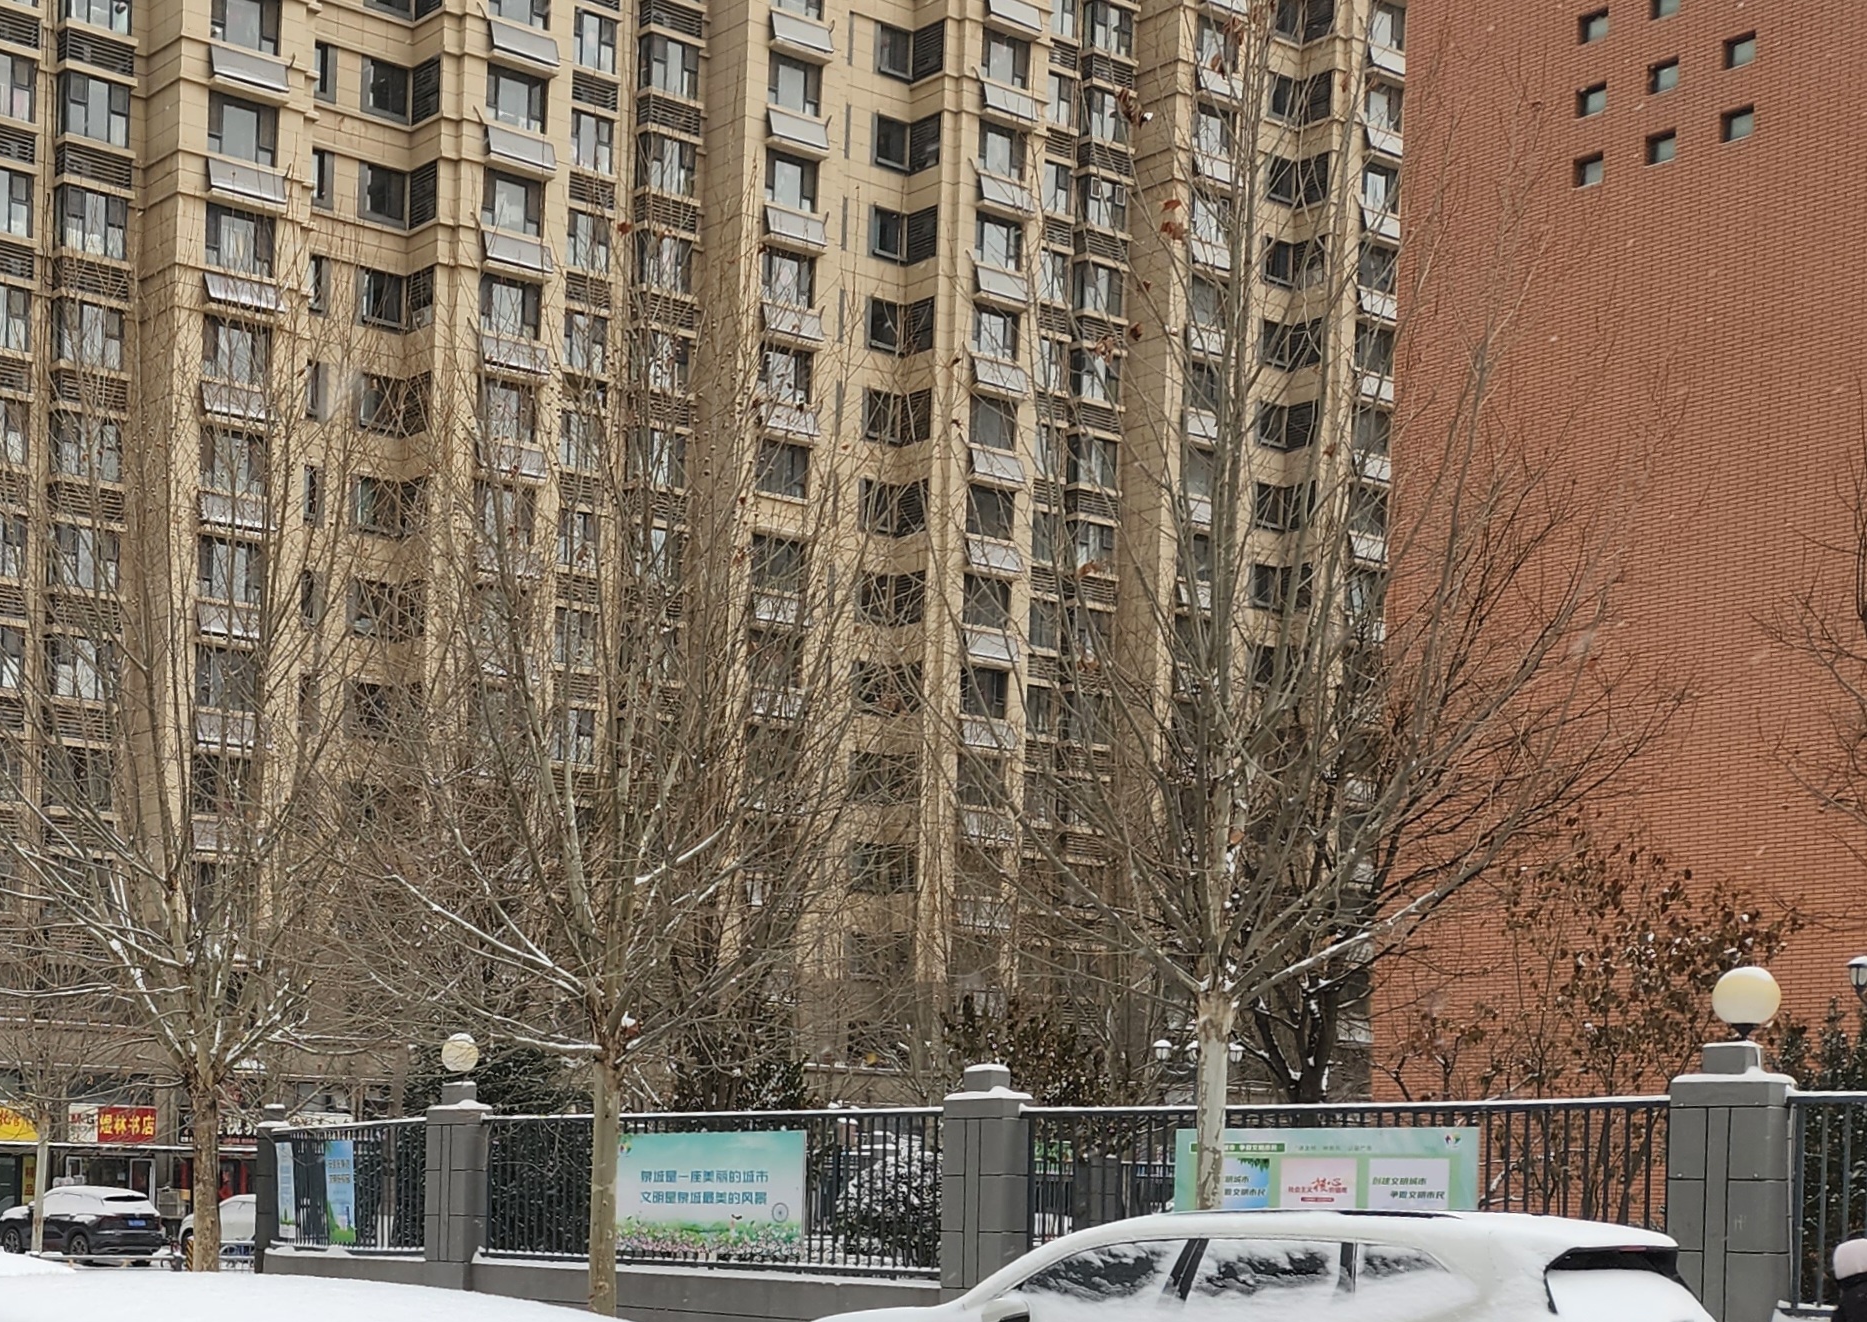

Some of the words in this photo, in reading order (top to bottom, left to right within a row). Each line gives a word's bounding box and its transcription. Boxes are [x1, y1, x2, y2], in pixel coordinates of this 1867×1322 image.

[99, 1113, 155, 1136] 煜林书店
[640, 1170, 769, 1183] 泉城是一座美丽的城市
[1224, 1175, 1250, 1184] 明城市
[1372, 1176, 1427, 1186] 创建文明城市
[1224, 1188, 1266, 1196] 取文明市民
[1389, 1189, 1446, 1200] 争取文明市民
[640, 1191, 767, 1205] 文明是泉城最美的风景
